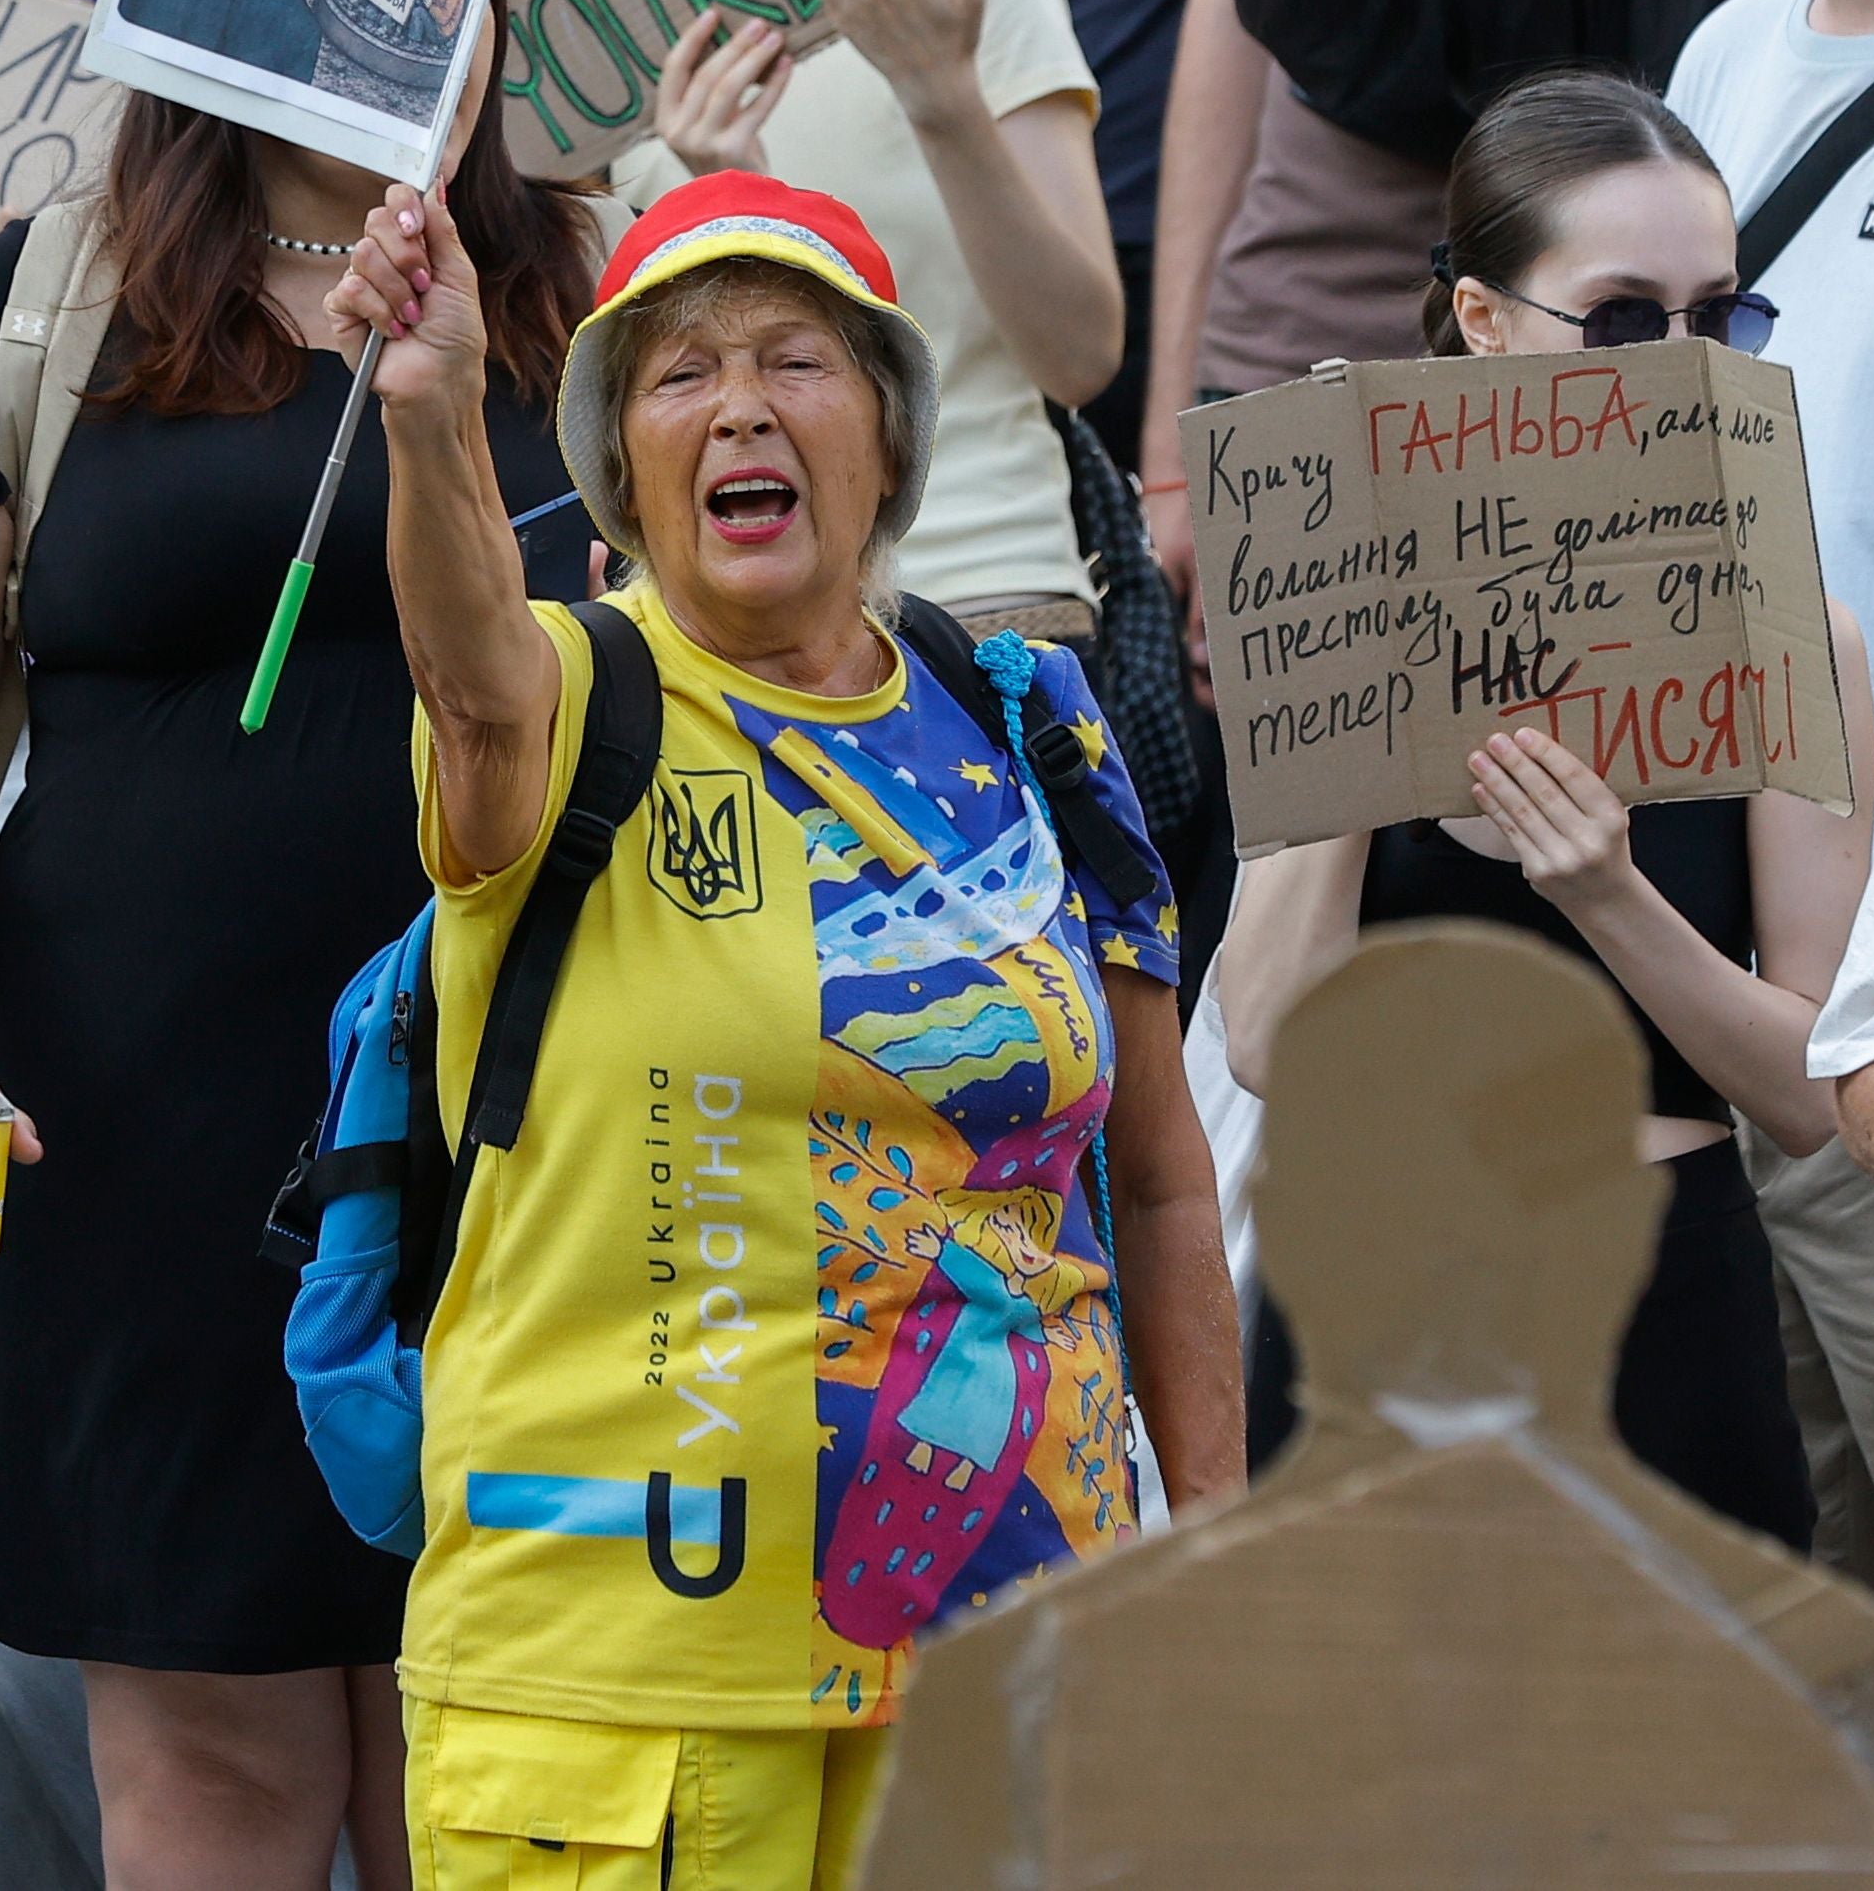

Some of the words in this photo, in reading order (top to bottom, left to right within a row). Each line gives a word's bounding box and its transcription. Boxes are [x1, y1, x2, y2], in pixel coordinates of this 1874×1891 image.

[1206, 425, 1336, 532] Кричу
[1453, 494, 1534, 562] НЕ
[1247, 670, 1414, 771] тепер
[1450, 629, 1584, 715] НАС
